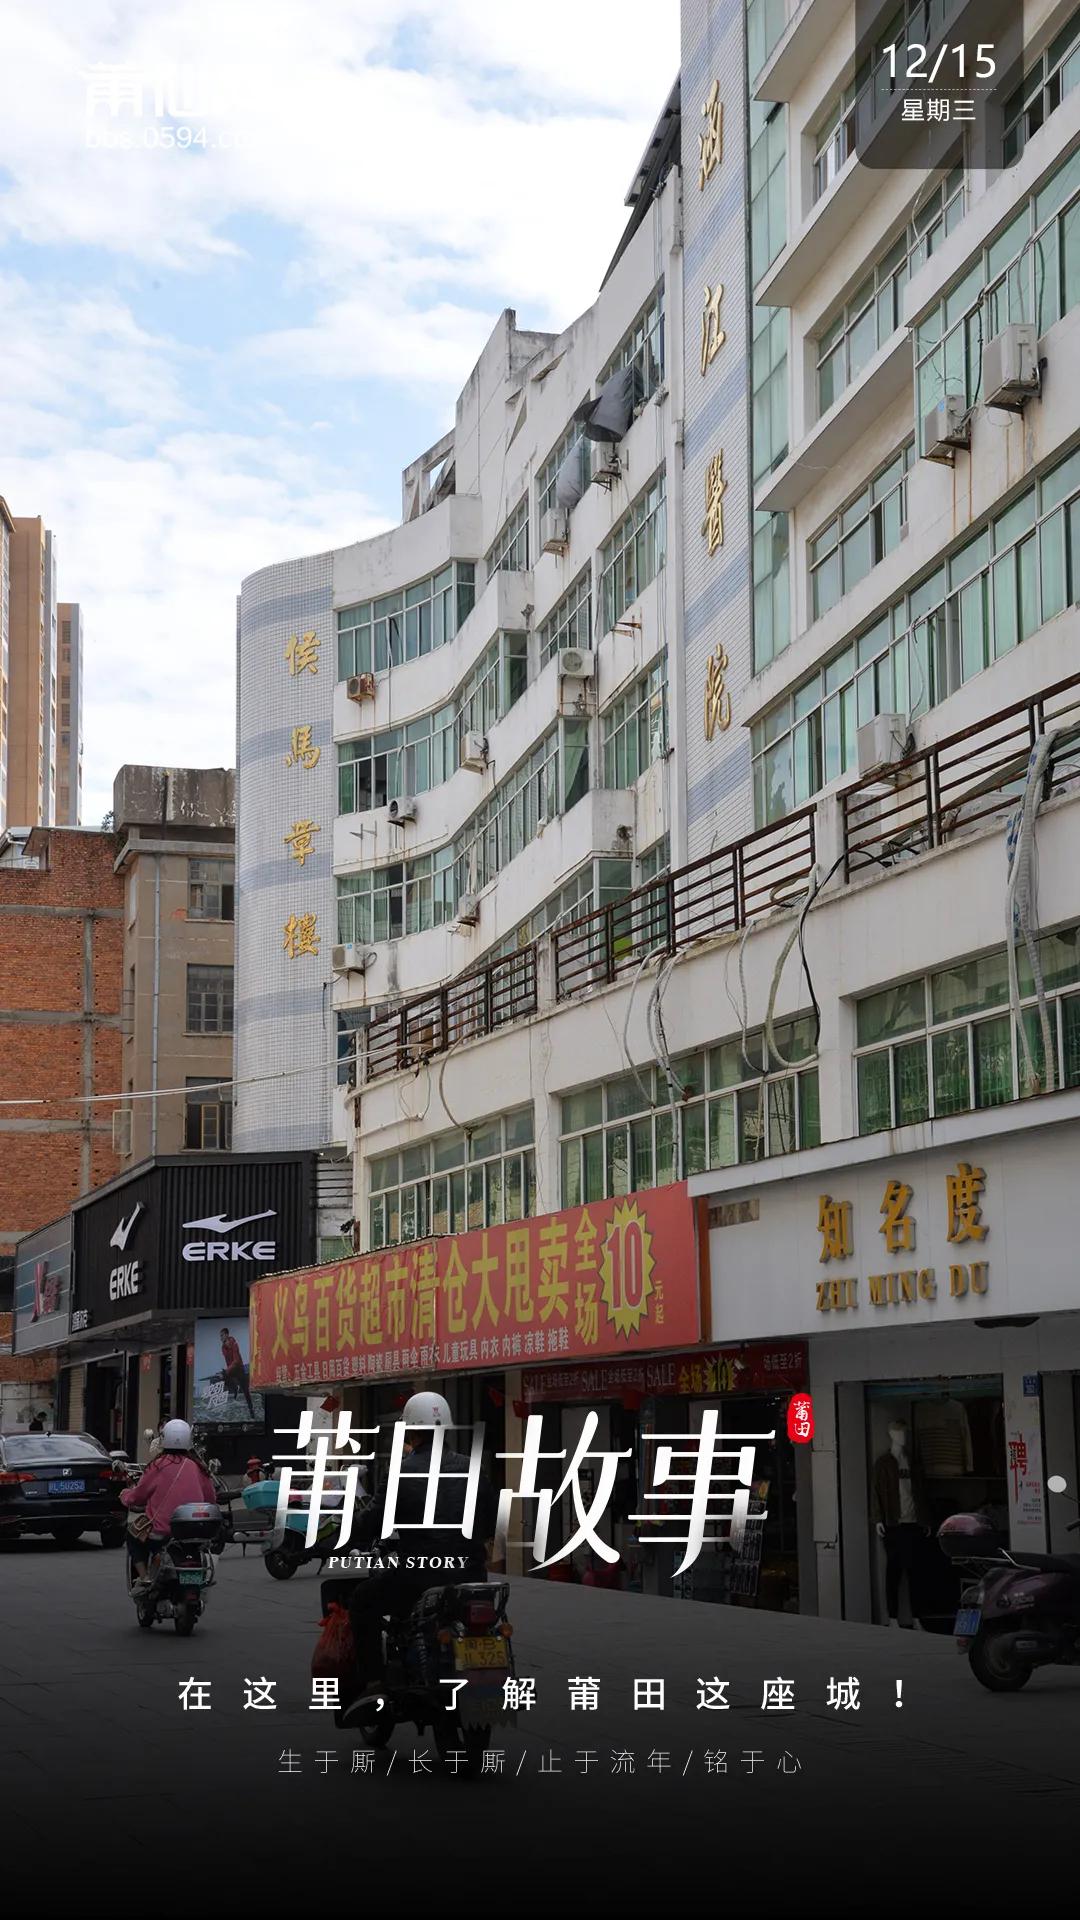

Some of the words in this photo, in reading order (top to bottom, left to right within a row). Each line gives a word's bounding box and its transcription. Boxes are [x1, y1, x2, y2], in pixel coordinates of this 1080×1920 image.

[817, 1161, 990, 1264] 知名度
[182, 1241, 276, 1262] ERKE
[606, 1220, 644, 1311] 10
[109, 1260, 140, 1300] ERKE
[272, 1217, 570, 1358] 义乌百货超市清仓大甩卖
[815, 1277, 859, 1312] ZHI
[868, 1267, 937, 1306] MING
[949, 1260, 990, 1297] DU
[646, 1362, 676, 1387] SALE
